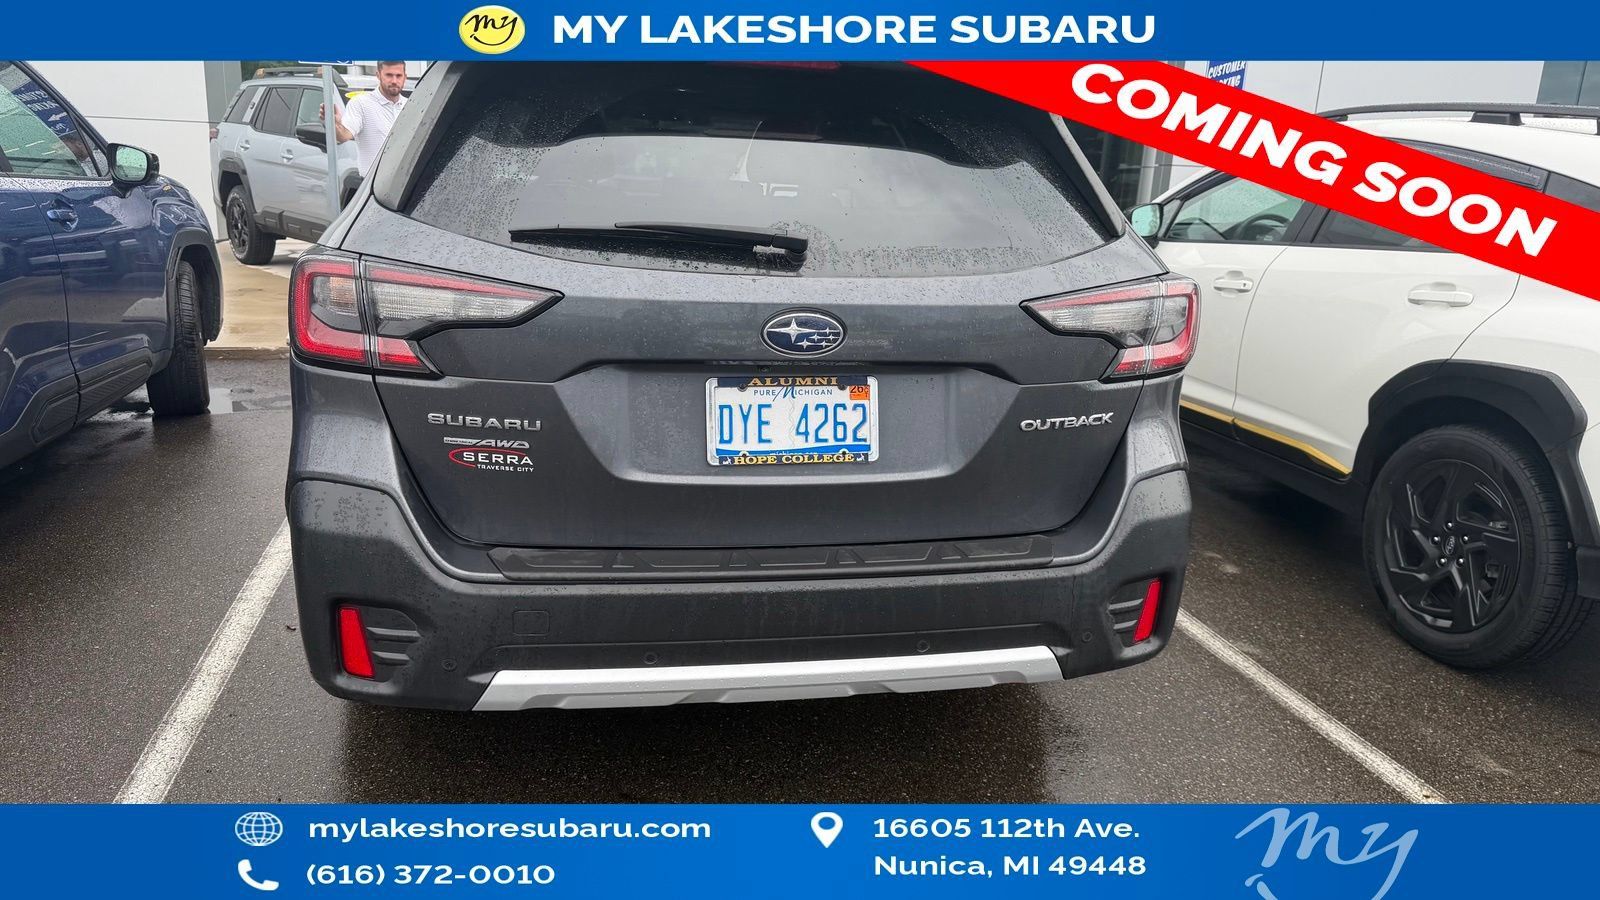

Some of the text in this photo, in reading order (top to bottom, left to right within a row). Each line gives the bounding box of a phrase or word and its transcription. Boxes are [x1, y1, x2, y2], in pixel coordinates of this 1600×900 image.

[1208, 60, 1246, 79] CUSTOMER
[748, 376, 838, 386] ALUMNI
[773, 385, 833, 402] MICHIGAN
[427, 412, 541, 431] SUBARU
[718, 403, 868, 444] DYE 4262
[1020, 412, 1114, 431] OUTBACK
[475, 439, 530, 449] AWD
[462, 451, 534, 466] SERRA
[734, 455, 777, 465] HOPE
[782, 453, 854, 464] COLLEGE
[477, 464, 514, 472] TRAVERSE
